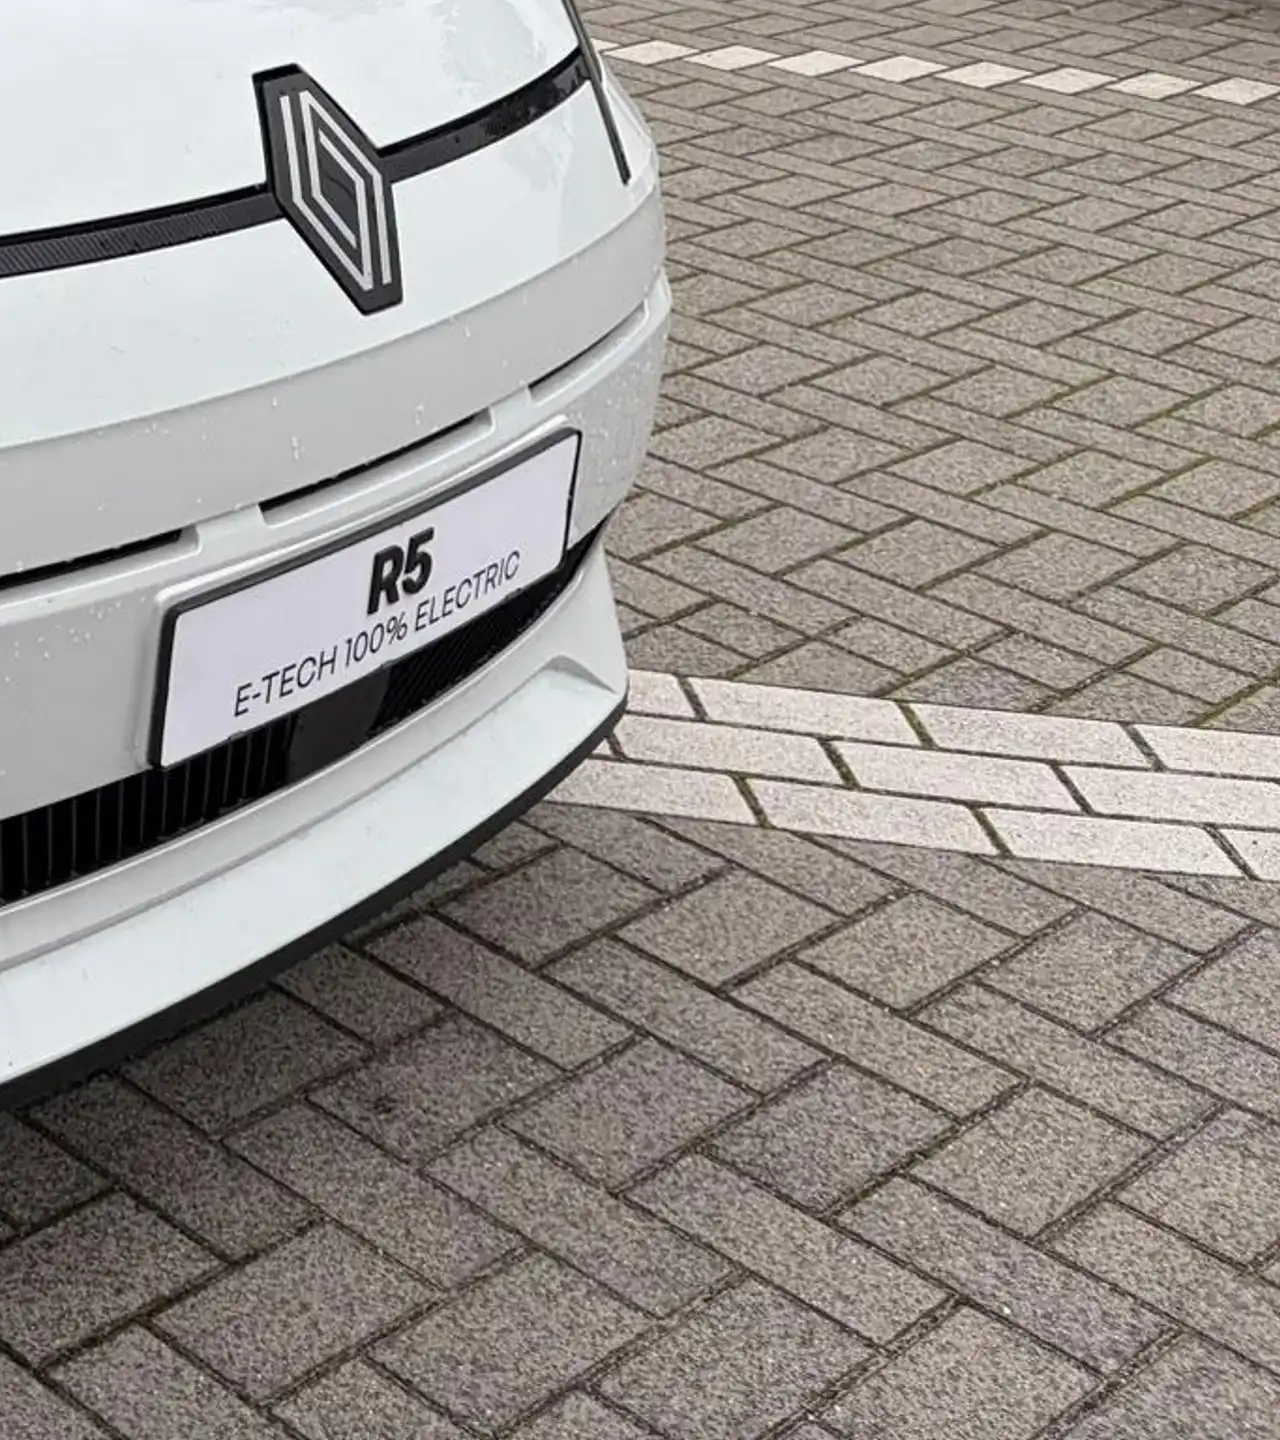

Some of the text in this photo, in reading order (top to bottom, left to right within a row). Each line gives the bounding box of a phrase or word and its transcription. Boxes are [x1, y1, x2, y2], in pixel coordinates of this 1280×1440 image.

[234, 550, 521, 718] E-TECH 100% ELECTRIC
[367, 526, 435, 615] R5
